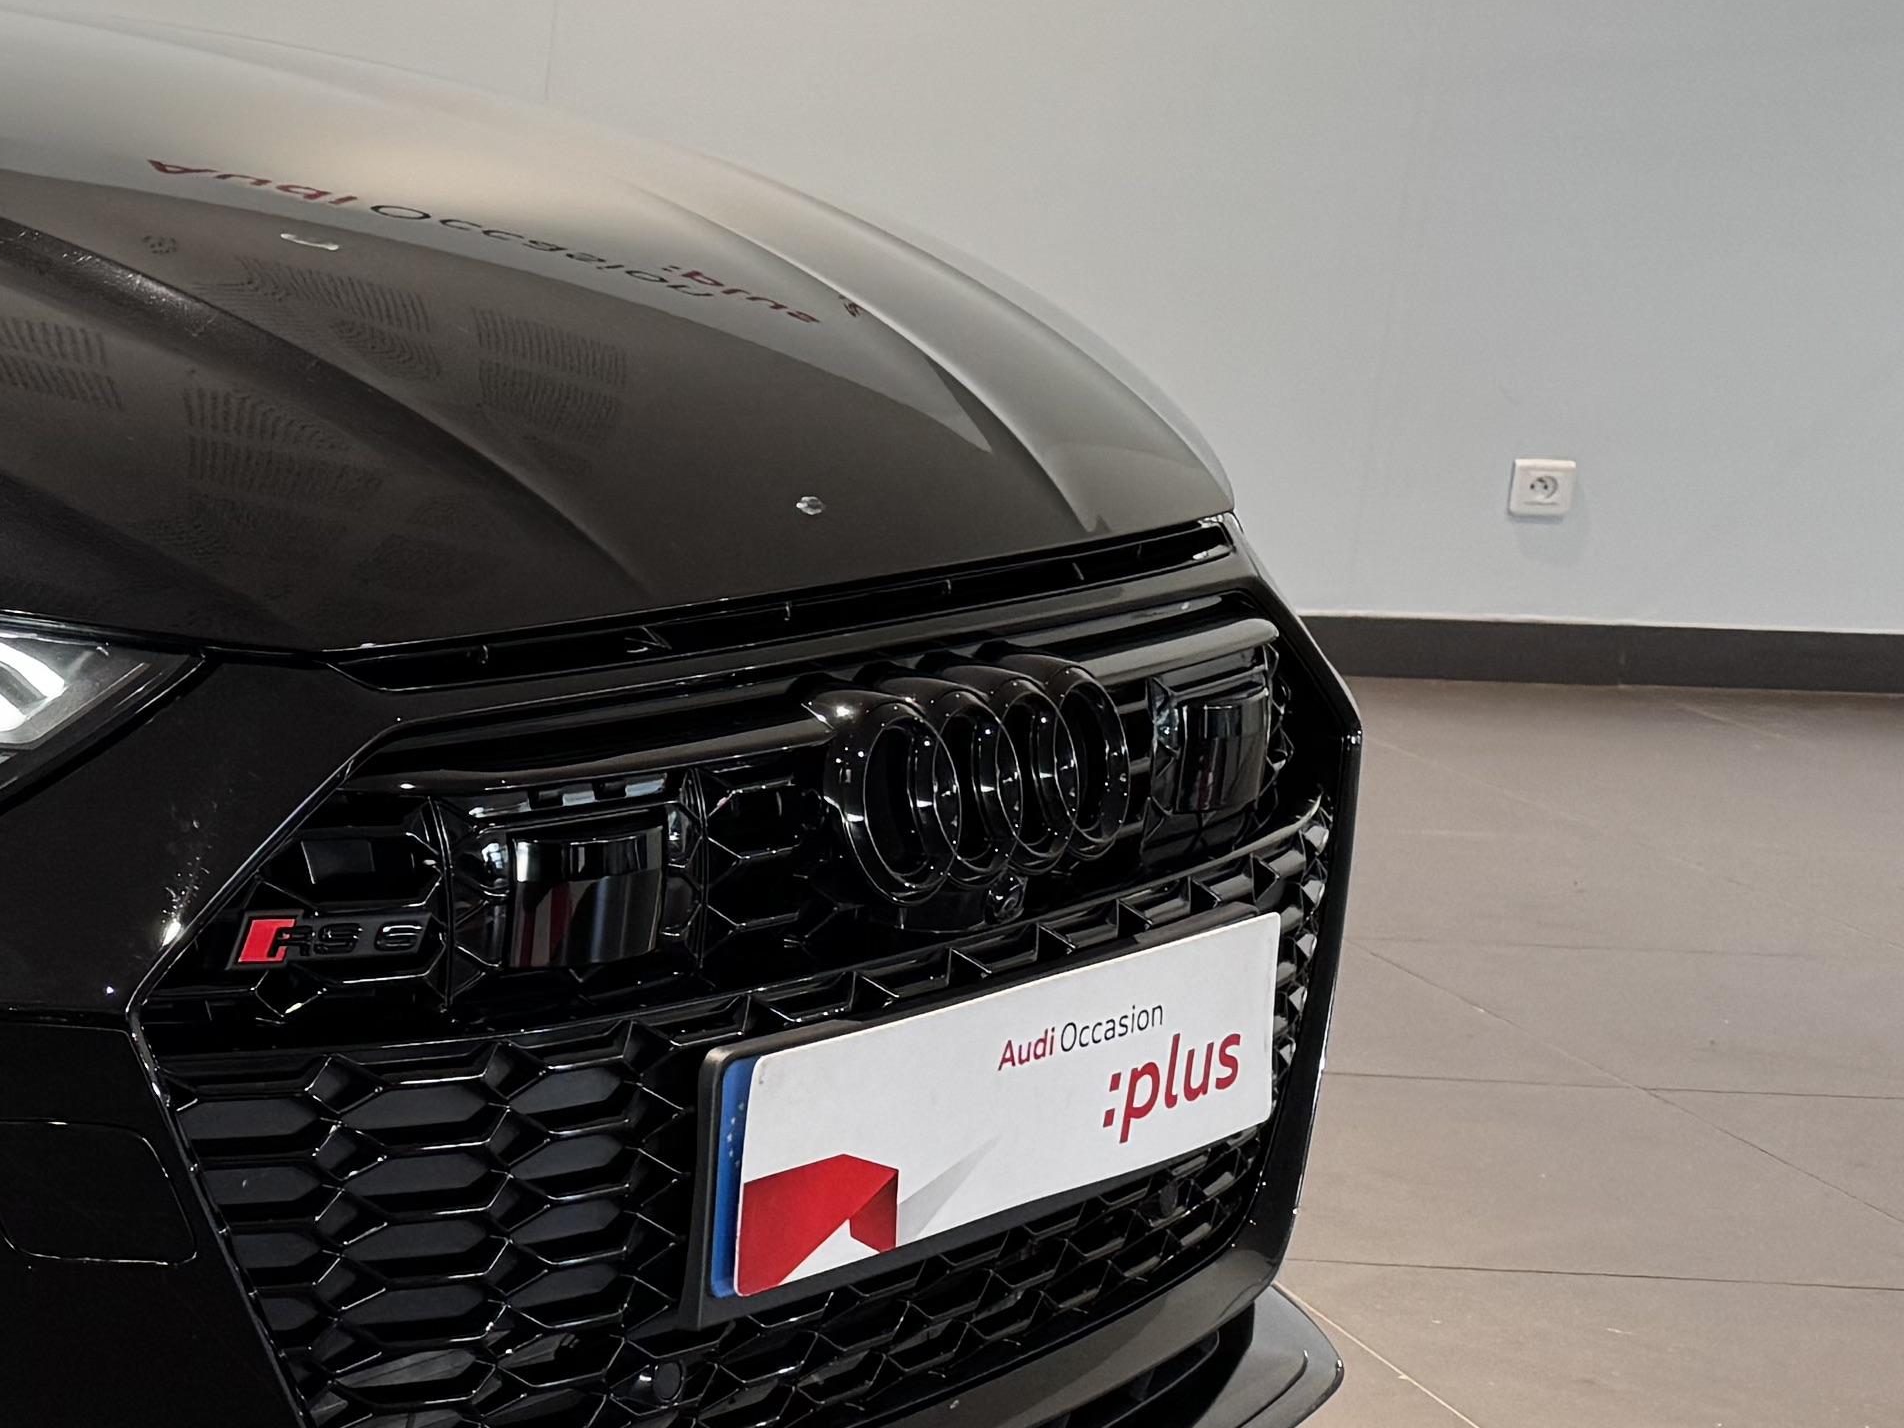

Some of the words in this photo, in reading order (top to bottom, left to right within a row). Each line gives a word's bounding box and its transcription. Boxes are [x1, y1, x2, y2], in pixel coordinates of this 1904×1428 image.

[267, 922, 363, 957] RS
[997, 1027, 1056, 1072] Audi
[1059, 1001, 1165, 1052] Occasion
[1101, 1031, 1243, 1144] :plus
